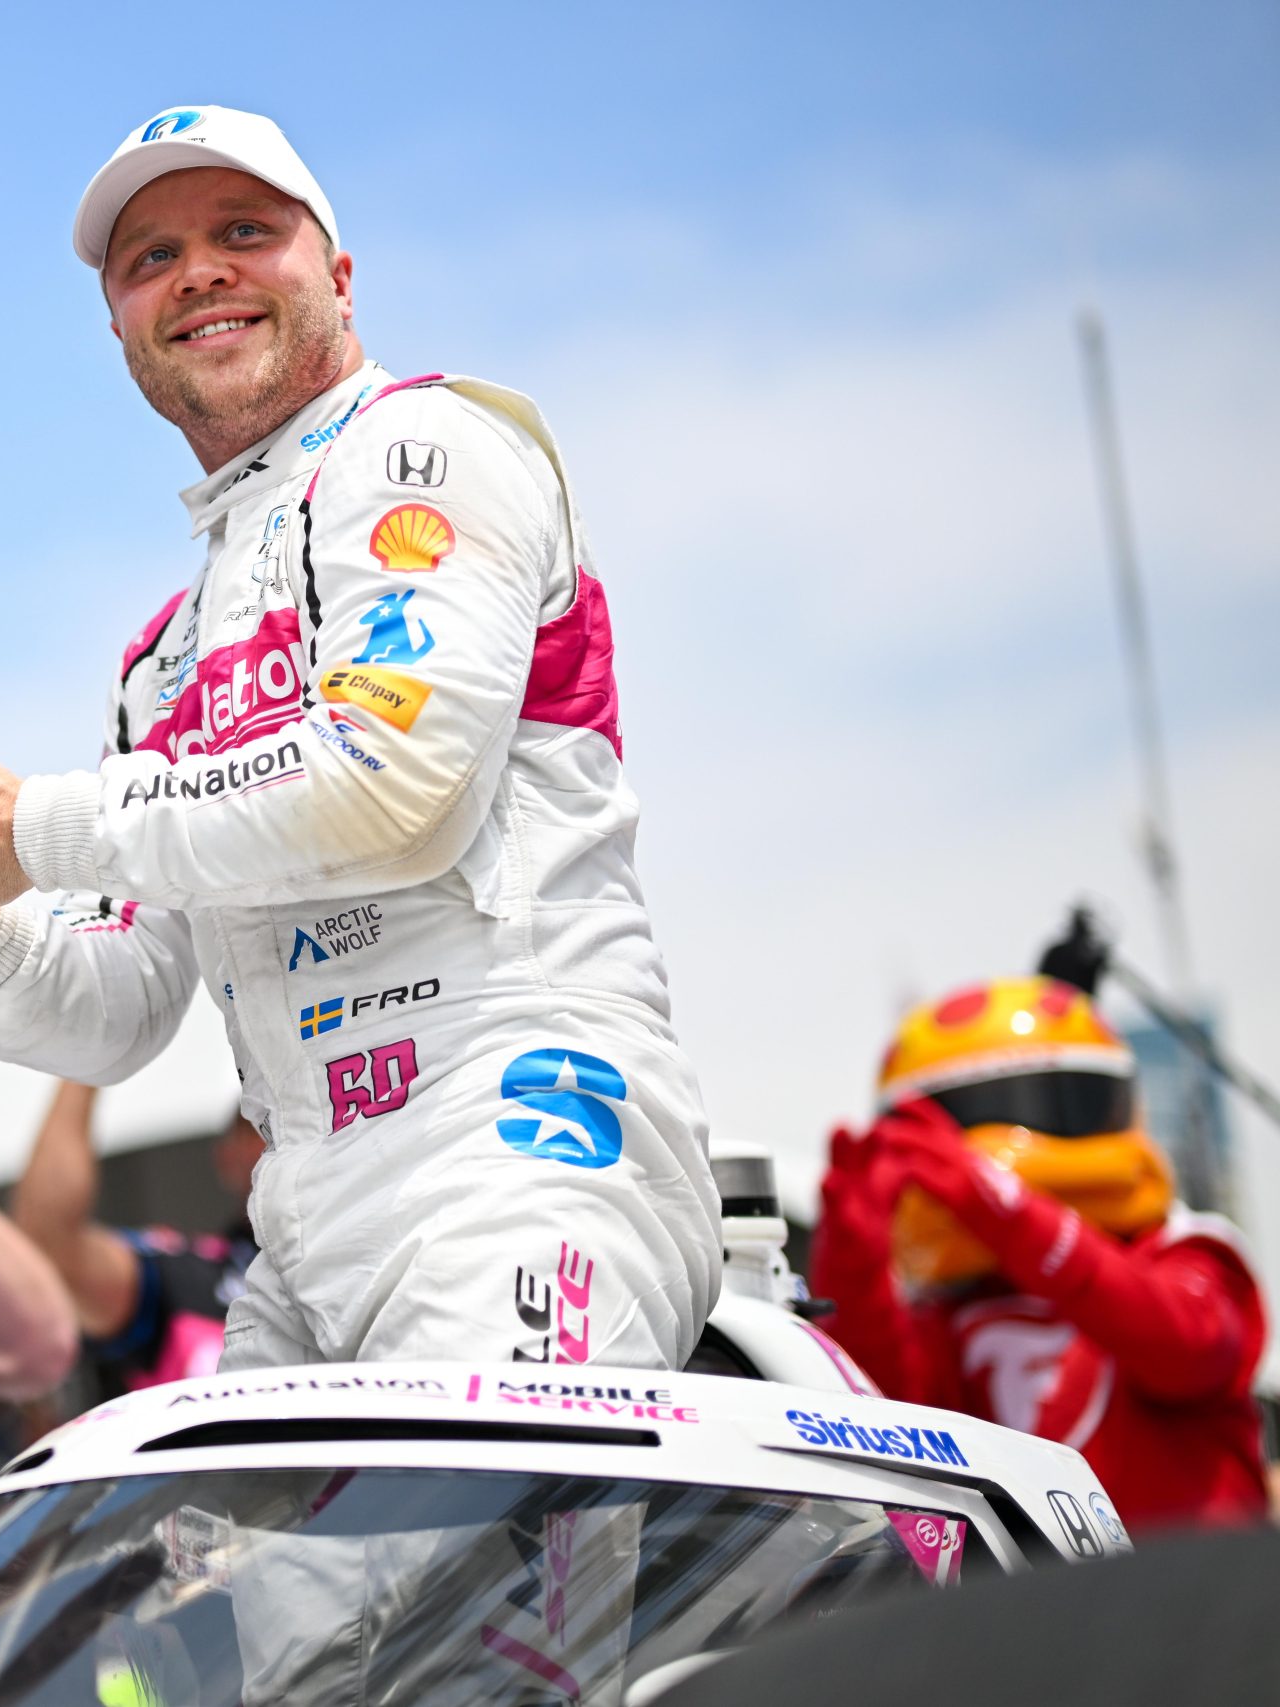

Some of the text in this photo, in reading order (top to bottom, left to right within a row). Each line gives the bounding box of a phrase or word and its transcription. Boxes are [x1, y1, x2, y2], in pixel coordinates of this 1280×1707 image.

[348, 673, 408, 709] Clopay
[362, 755, 387, 772] RV
[315, 903, 383, 940] ARCTIC
[328, 924, 382, 957] WOLF
[352, 977, 441, 1018] FRO
[496, 1381, 672, 1405] MOBILE
[496, 1393, 700, 1424] SERVICE
[785, 1409, 970, 1468] SiriusXM
